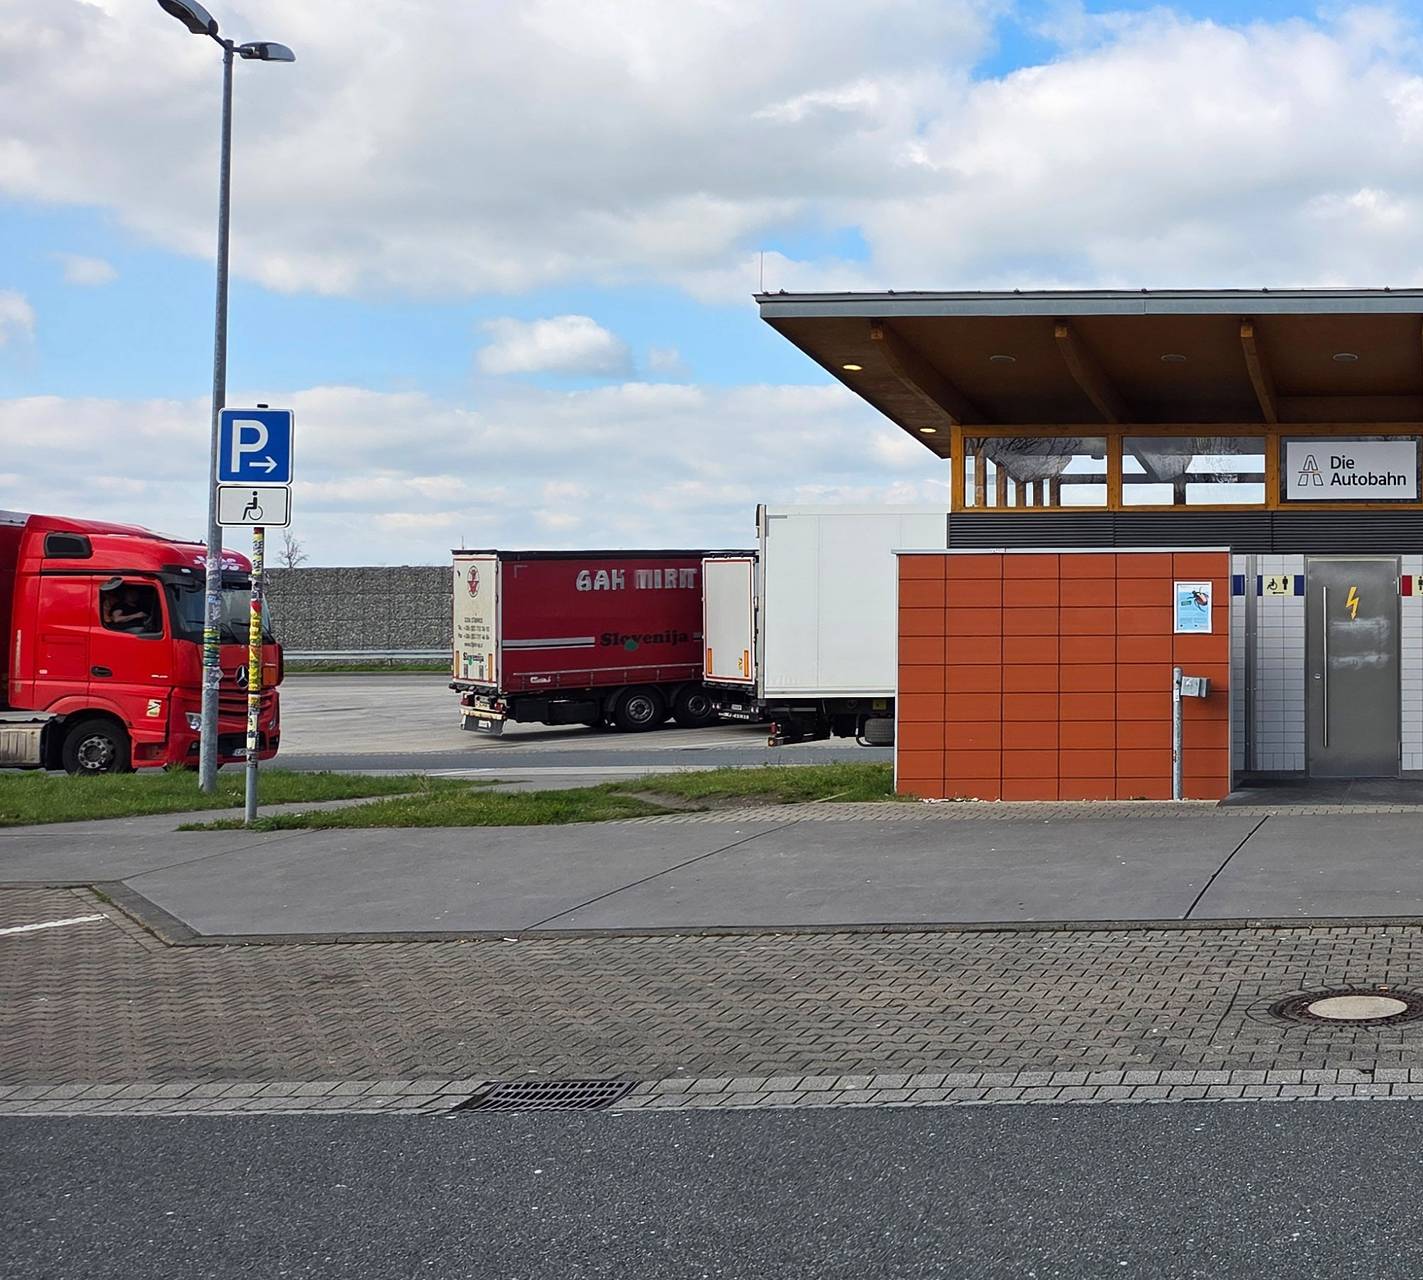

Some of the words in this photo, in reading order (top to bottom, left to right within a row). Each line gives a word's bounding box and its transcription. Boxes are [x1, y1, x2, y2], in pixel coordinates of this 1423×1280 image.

[231, 419, 269, 473] P
[1330, 455, 1355, 470] Die
[1330, 472, 1407, 486] Autobahn
[601, 630, 689, 647] Slovenija
